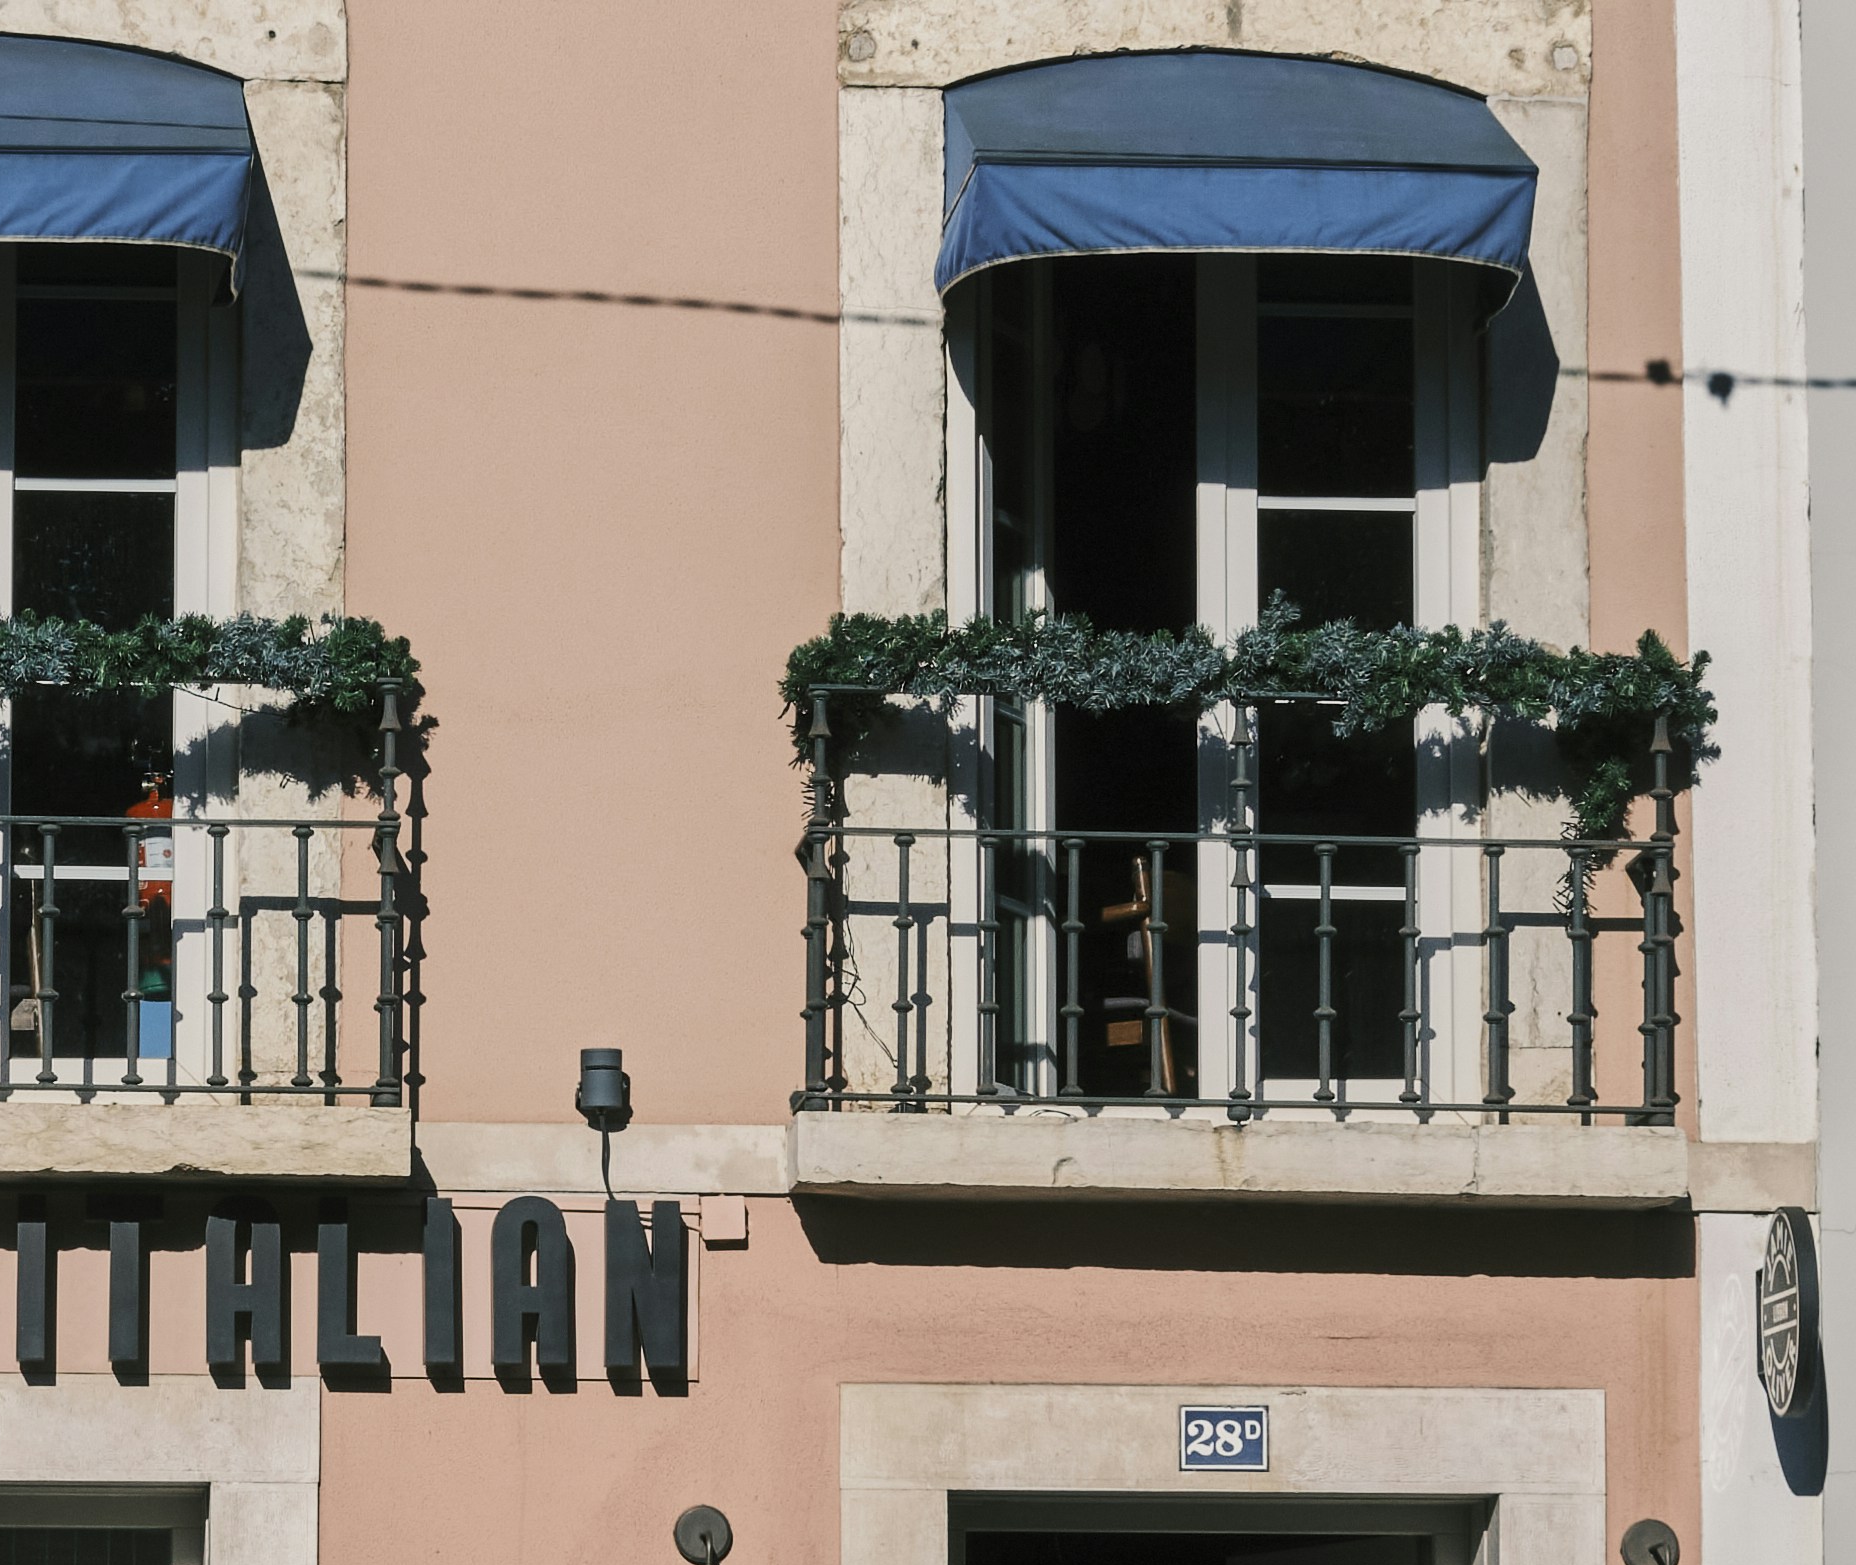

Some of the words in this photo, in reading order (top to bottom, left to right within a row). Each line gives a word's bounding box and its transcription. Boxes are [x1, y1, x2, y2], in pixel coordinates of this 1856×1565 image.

[14, 1190, 682, 1369] ITALIAN
[1764, 1337, 1797, 1404] OLIVER
[1186, 1419, 1262, 1457] 28D
